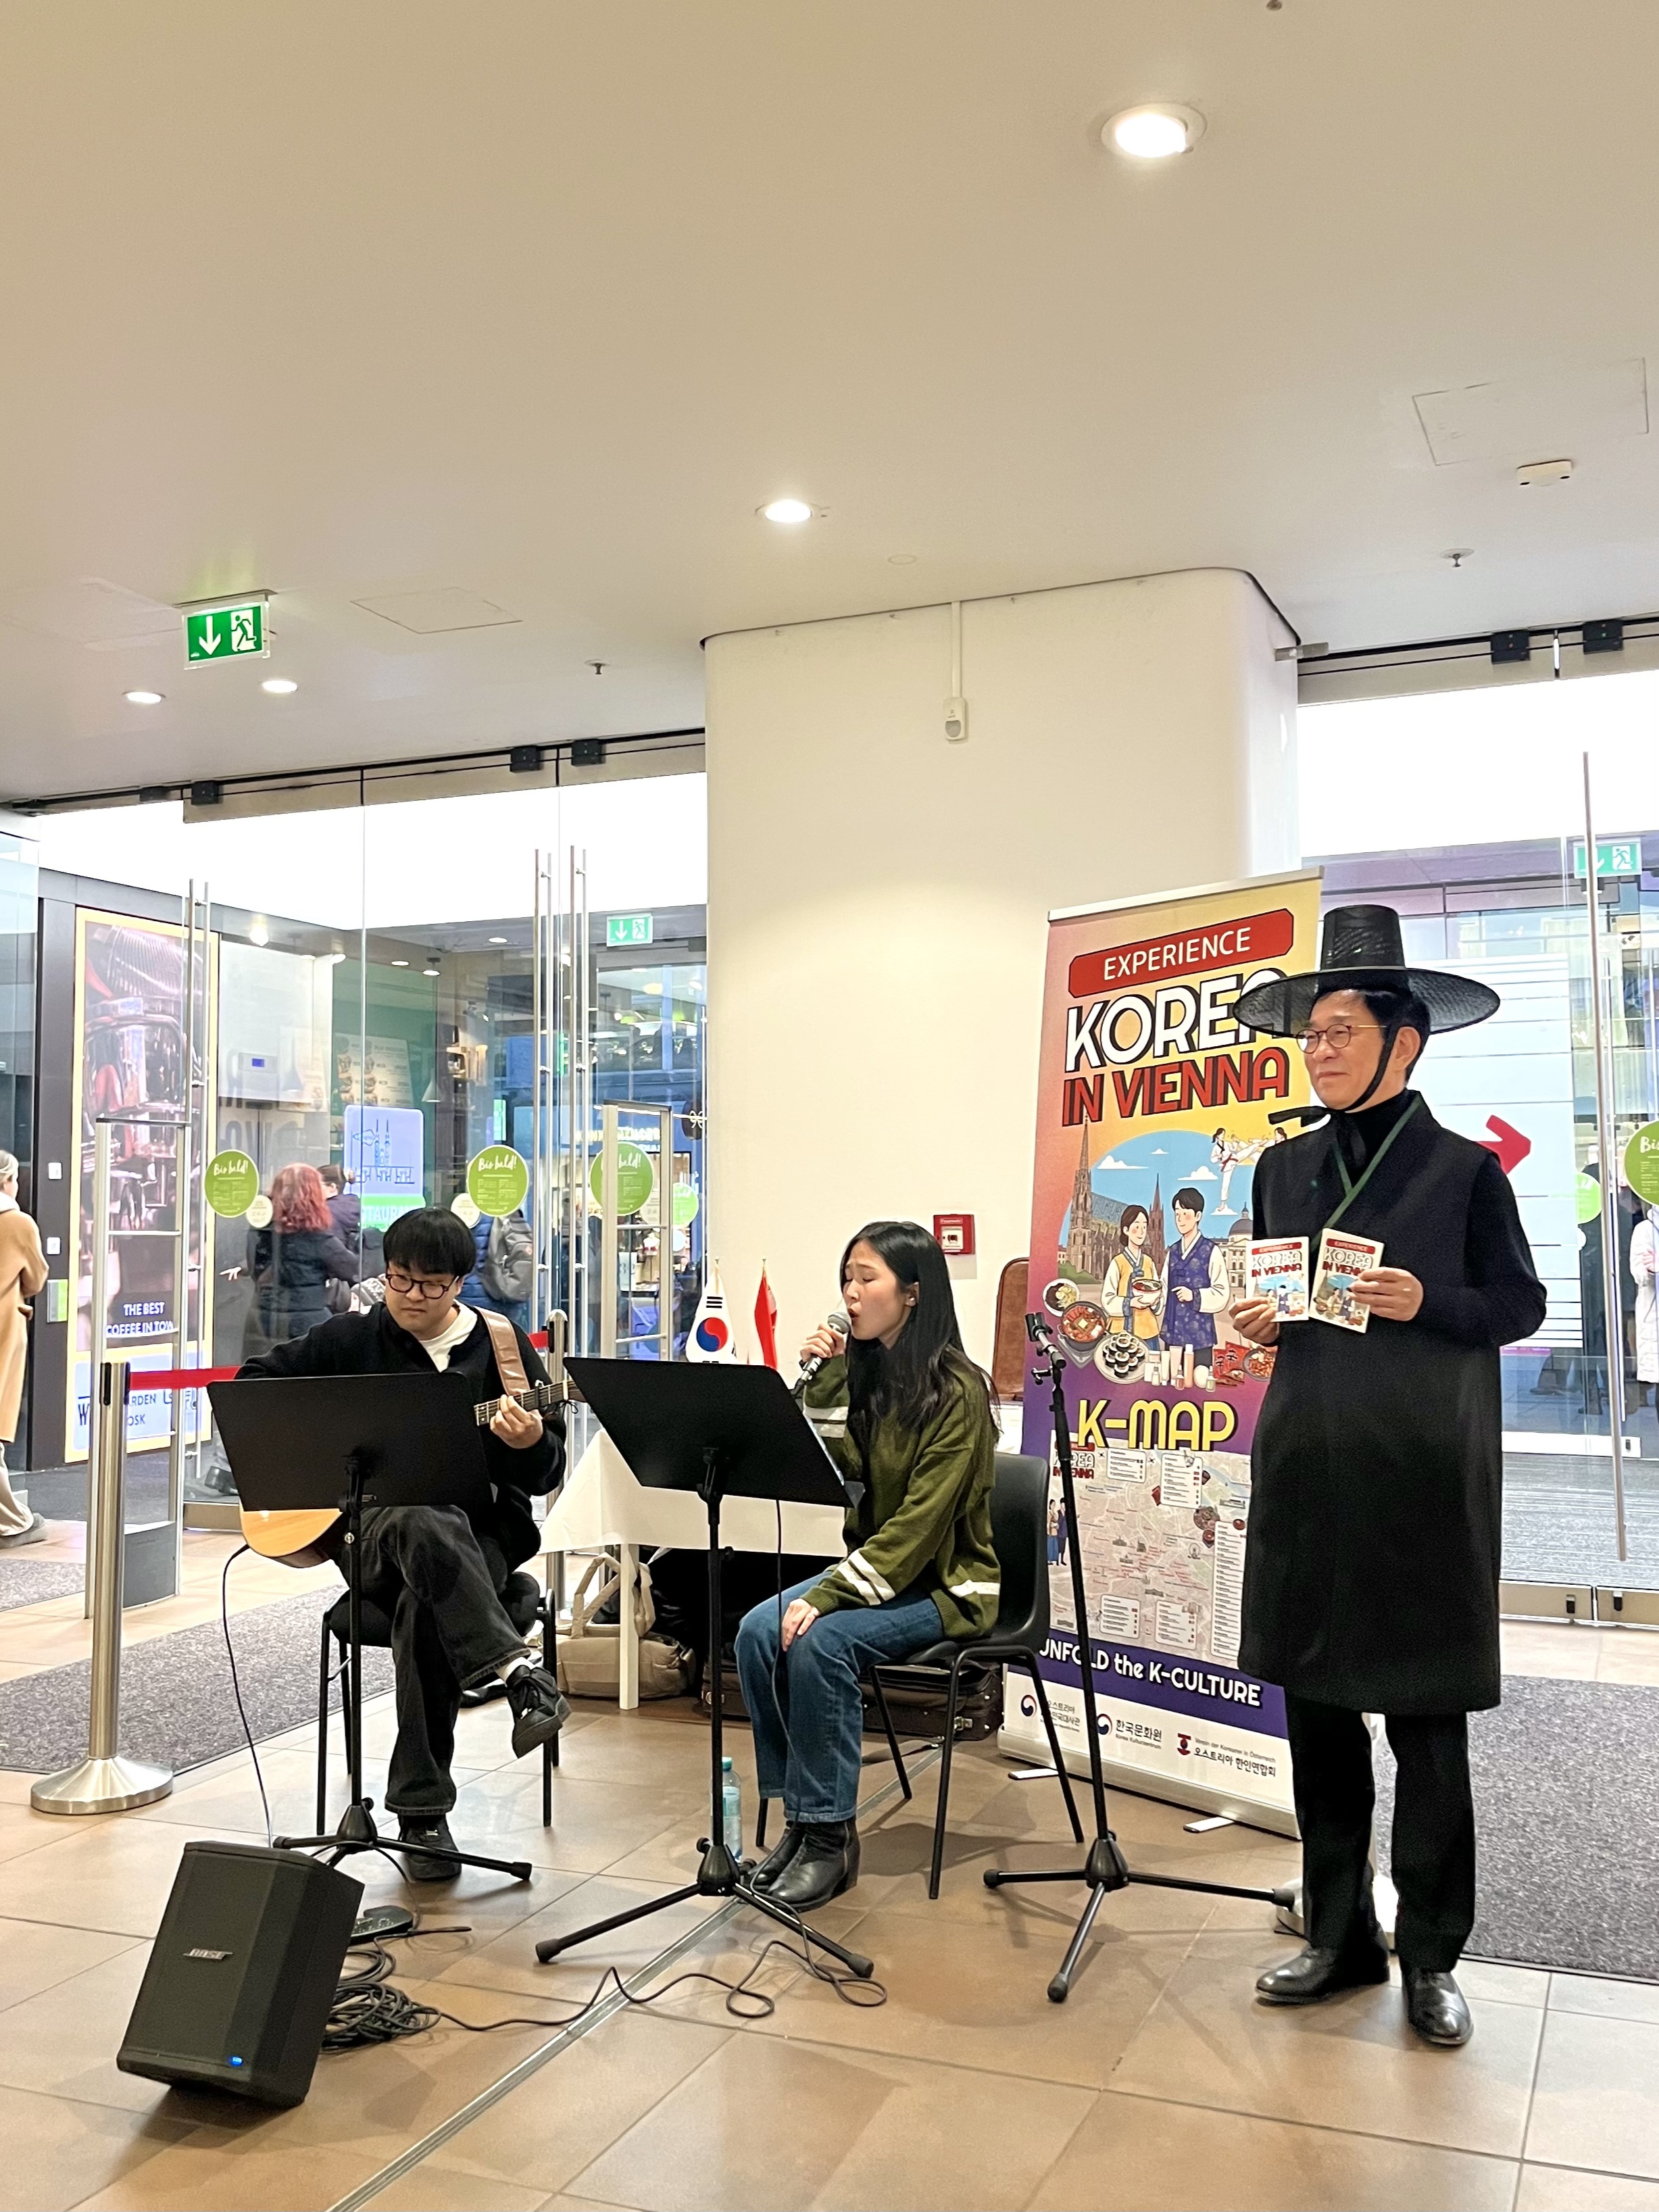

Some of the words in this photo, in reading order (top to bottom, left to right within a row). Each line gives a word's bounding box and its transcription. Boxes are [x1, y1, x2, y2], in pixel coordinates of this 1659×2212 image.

[1103, 927, 1252, 981] EXPERIENCE
[1062, 1077, 1104, 1127] IN
[1111, 1047, 1289, 1118] VIENNA
[478, 1158, 494, 1172] Bis
[1252, 1250, 1303, 1268] KOREA
[1322, 1261, 1333, 1271] IN
[1323, 1247, 1374, 1269] KOREA
[1252, 1268, 1262, 1277] IN
[1263, 1263, 1302, 1275] VIENNA
[124, 1303, 142, 1316] THE
[143, 1302, 165, 1315] BEST
[105, 1322, 141, 1335] COFFEE
[142, 1322, 153, 1333] IN
[1077, 1399, 1237, 1452] K-MAP
[1114, 1654, 1144, 1679] the
[1149, 1661, 1261, 1706] K-CULTURE
[1116, 1719, 1162, 1743] 한국문화원
[1193, 1747, 1233, 1766] 오스트리아
[1235, 1757, 1277, 1777] 한인연합회
